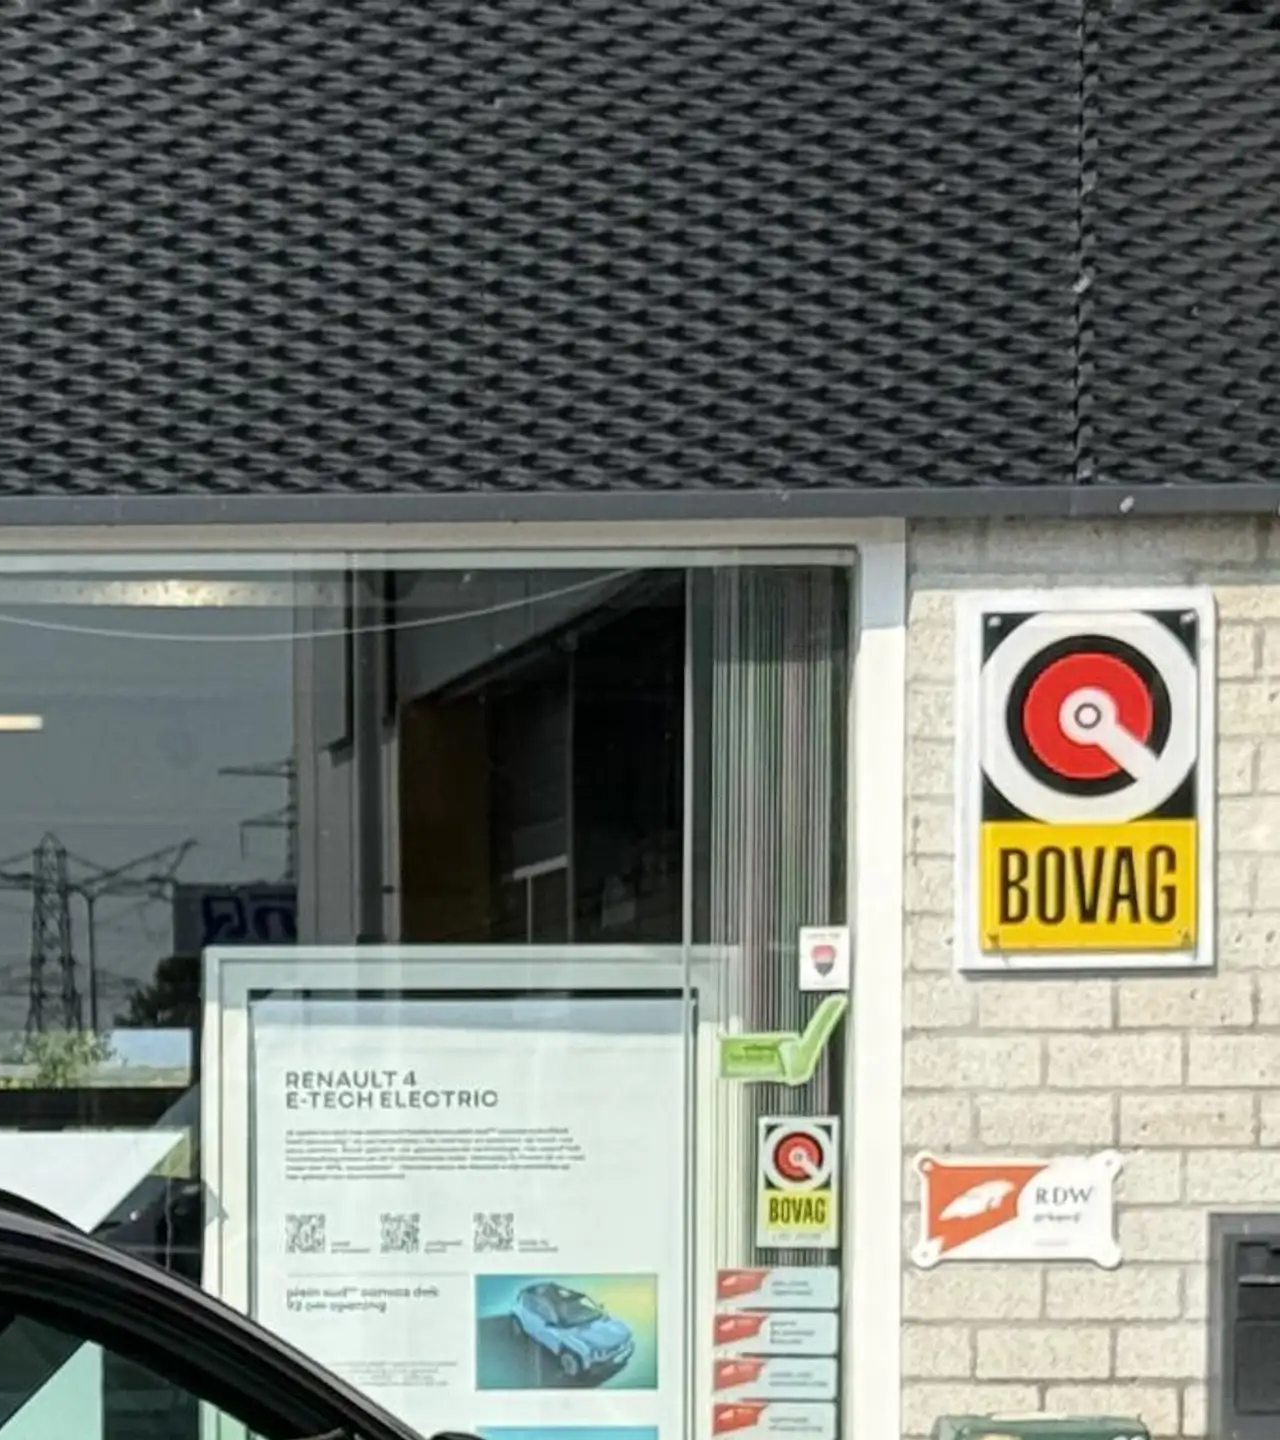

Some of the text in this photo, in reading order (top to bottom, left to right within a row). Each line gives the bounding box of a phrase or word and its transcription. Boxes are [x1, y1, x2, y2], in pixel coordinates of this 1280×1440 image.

[998, 844, 1178, 925] BOVAG
[285, 1070, 417, 1090] RENAULT 4
[285, 1089, 500, 1110] E-TECH ELECTRIC
[1035, 1186, 1095, 1206] RDW
[768, 1197, 827, 1224] BOVAG
